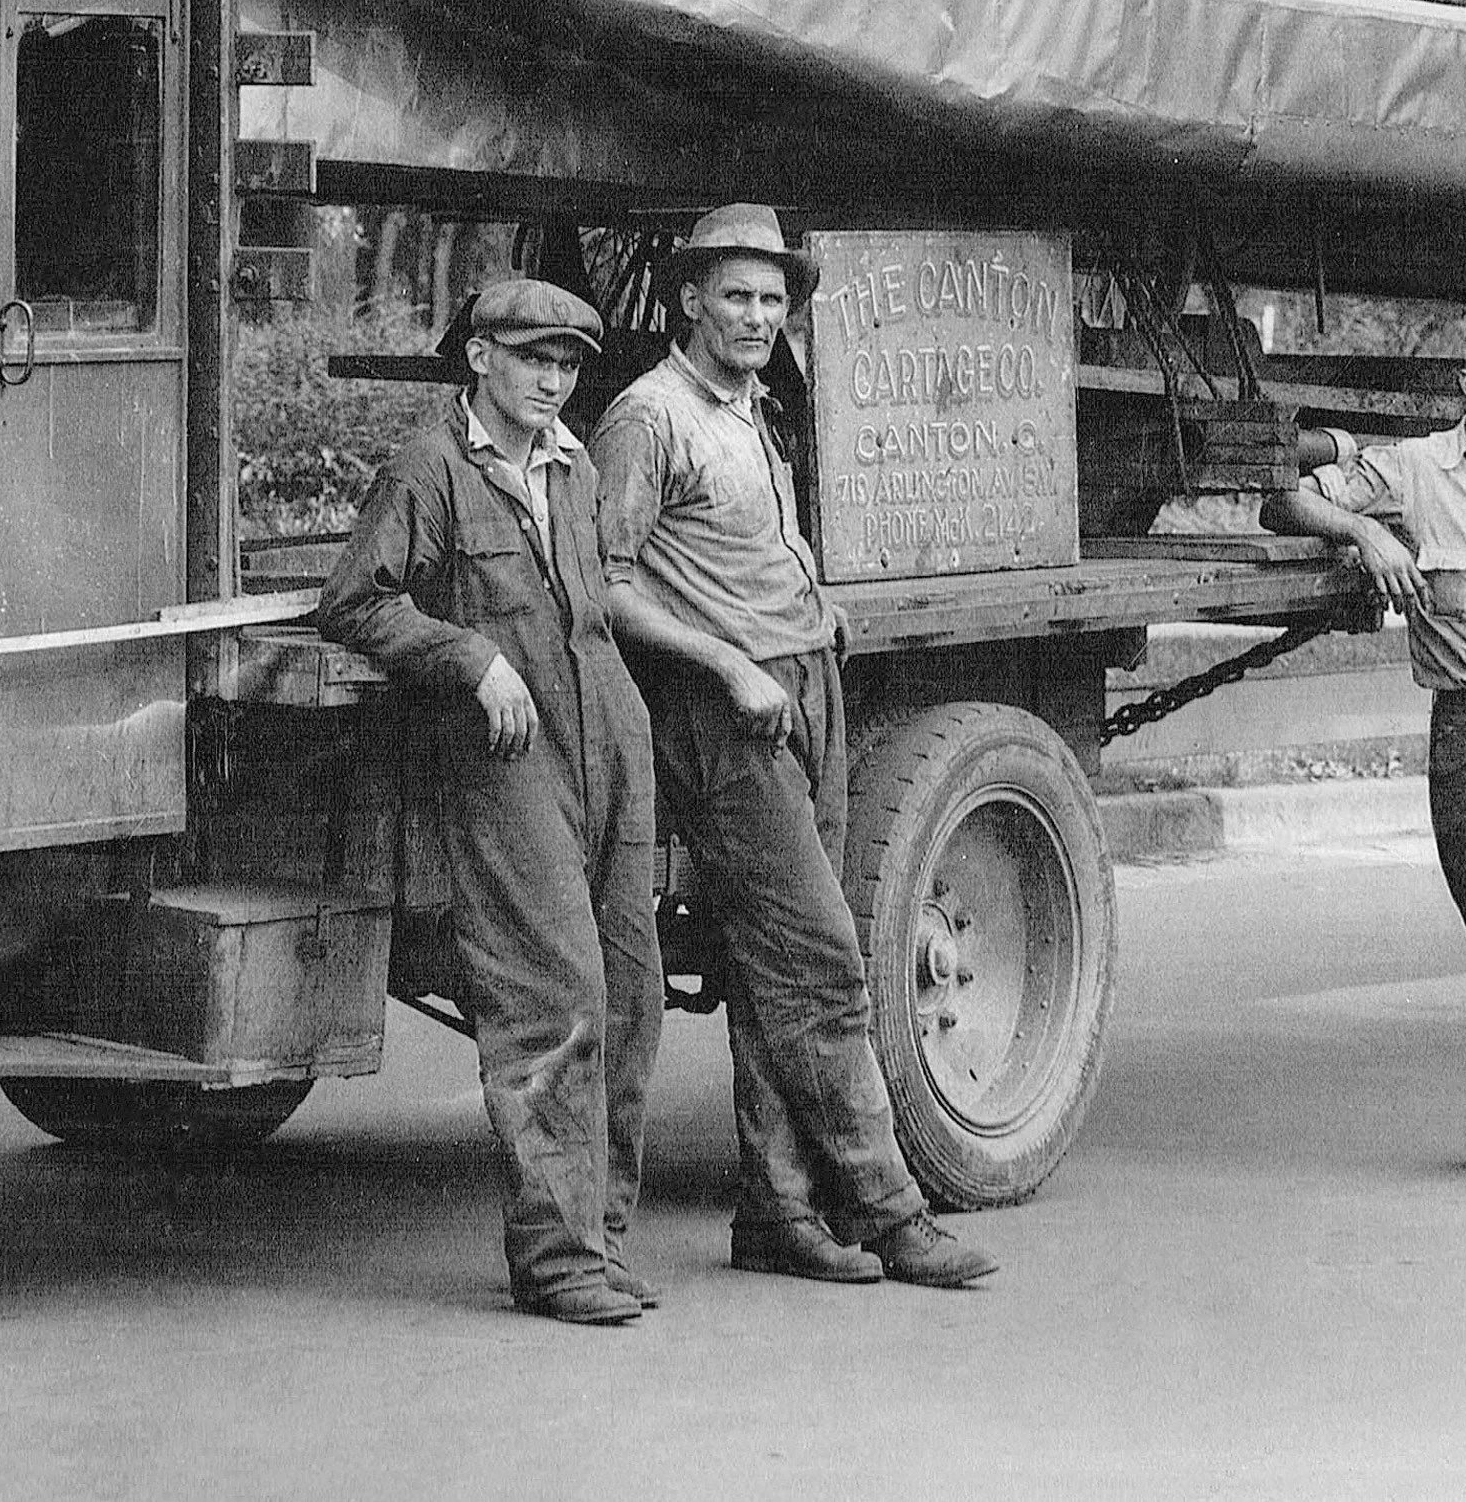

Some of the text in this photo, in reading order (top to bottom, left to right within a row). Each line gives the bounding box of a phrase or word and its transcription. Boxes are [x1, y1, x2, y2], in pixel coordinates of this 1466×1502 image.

[831, 258, 1061, 348] THE CANTON
[851, 344, 994, 408] CARTAGE
[872, 467, 985, 507] ARLINGTON
[863, 506, 927, 547] PHONE
